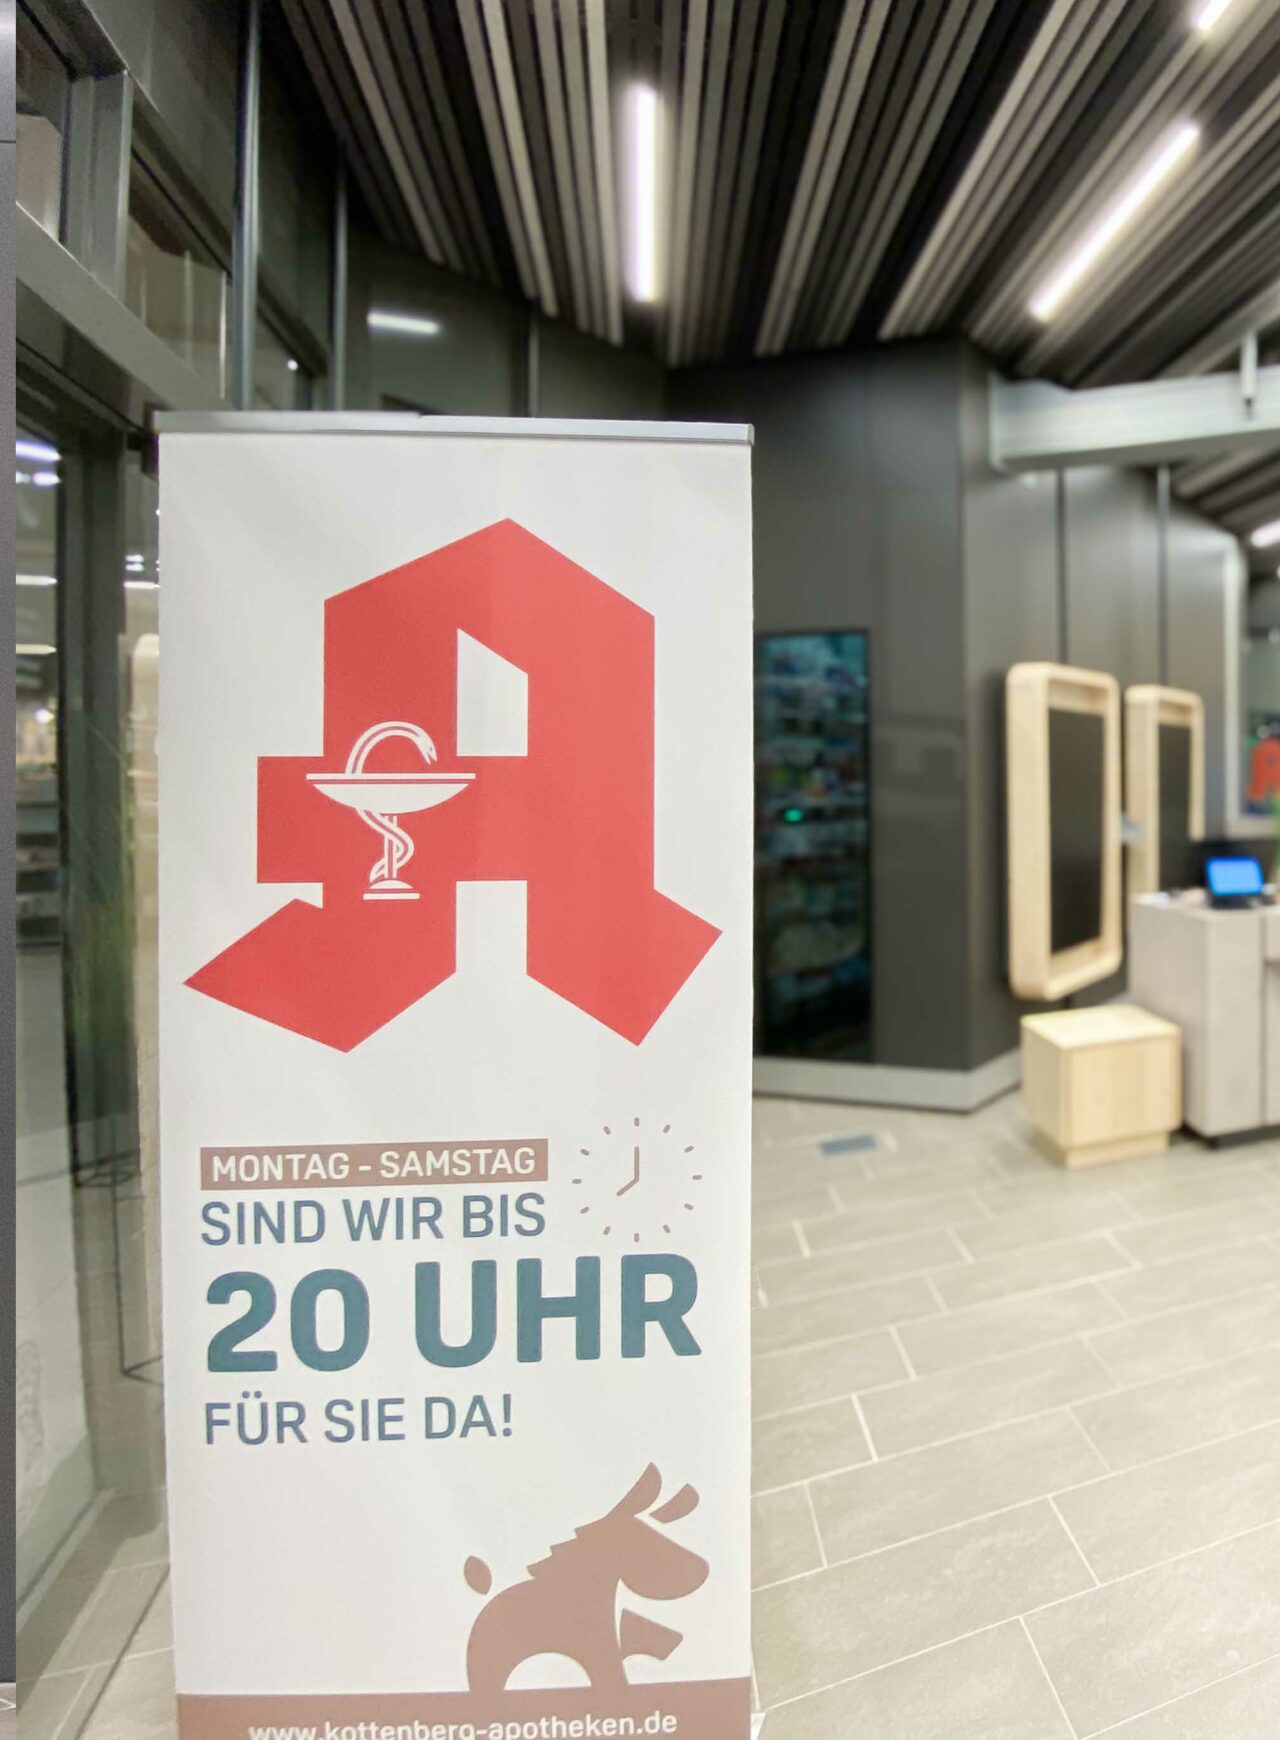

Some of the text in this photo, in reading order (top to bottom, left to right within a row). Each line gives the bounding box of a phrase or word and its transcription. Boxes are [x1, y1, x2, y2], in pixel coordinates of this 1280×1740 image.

[212, 1152, 350, 1182] MONTAG
[379, 1147, 536, 1178] SAMSTAG
[201, 1192, 546, 1246] SIND WIR BIS
[206, 1252, 702, 1373] 20 UHR
[205, 1390, 514, 1445] FÜR SIE DA!
[248, 1710, 678, 1740] www.kottenberg-apotheken.de
